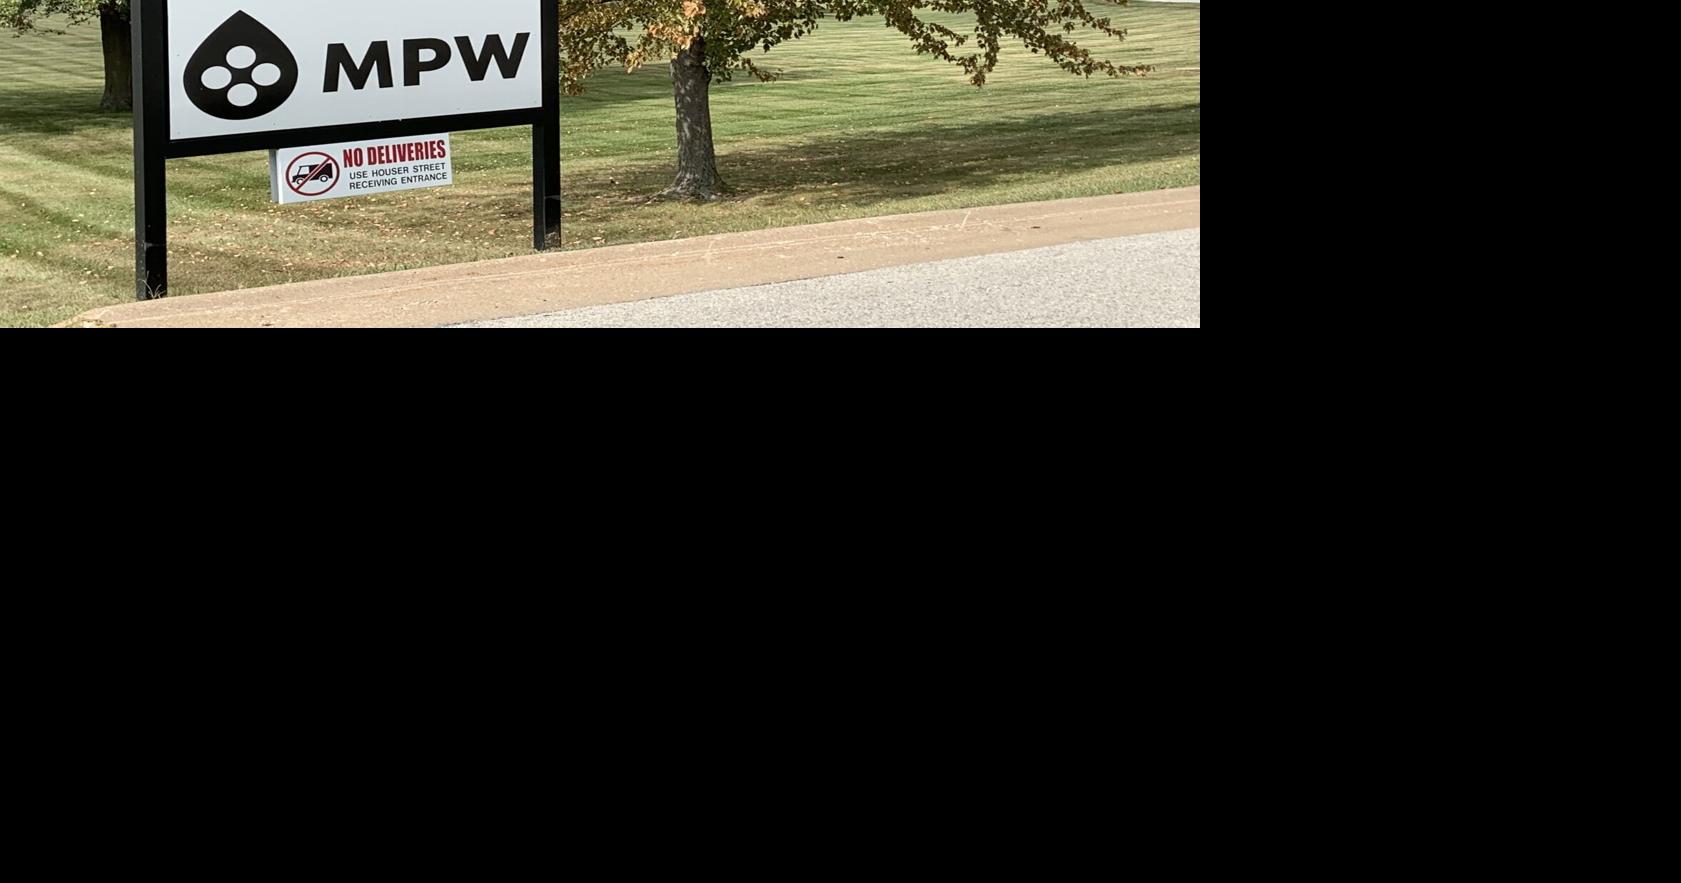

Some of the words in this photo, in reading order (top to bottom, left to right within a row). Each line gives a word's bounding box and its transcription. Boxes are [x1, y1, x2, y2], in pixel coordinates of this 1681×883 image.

[322, 32, 530, 93] MPW
[343, 147, 363, 168] NO
[367, 139, 446, 165] DELIVERIES
[349, 170, 368, 180] USE
[372, 166, 409, 177] HOUSER
[413, 162, 446, 173] STREET
[349, 178, 398, 190] RECEIVING
[401, 172, 447, 184] ENTRANCE
